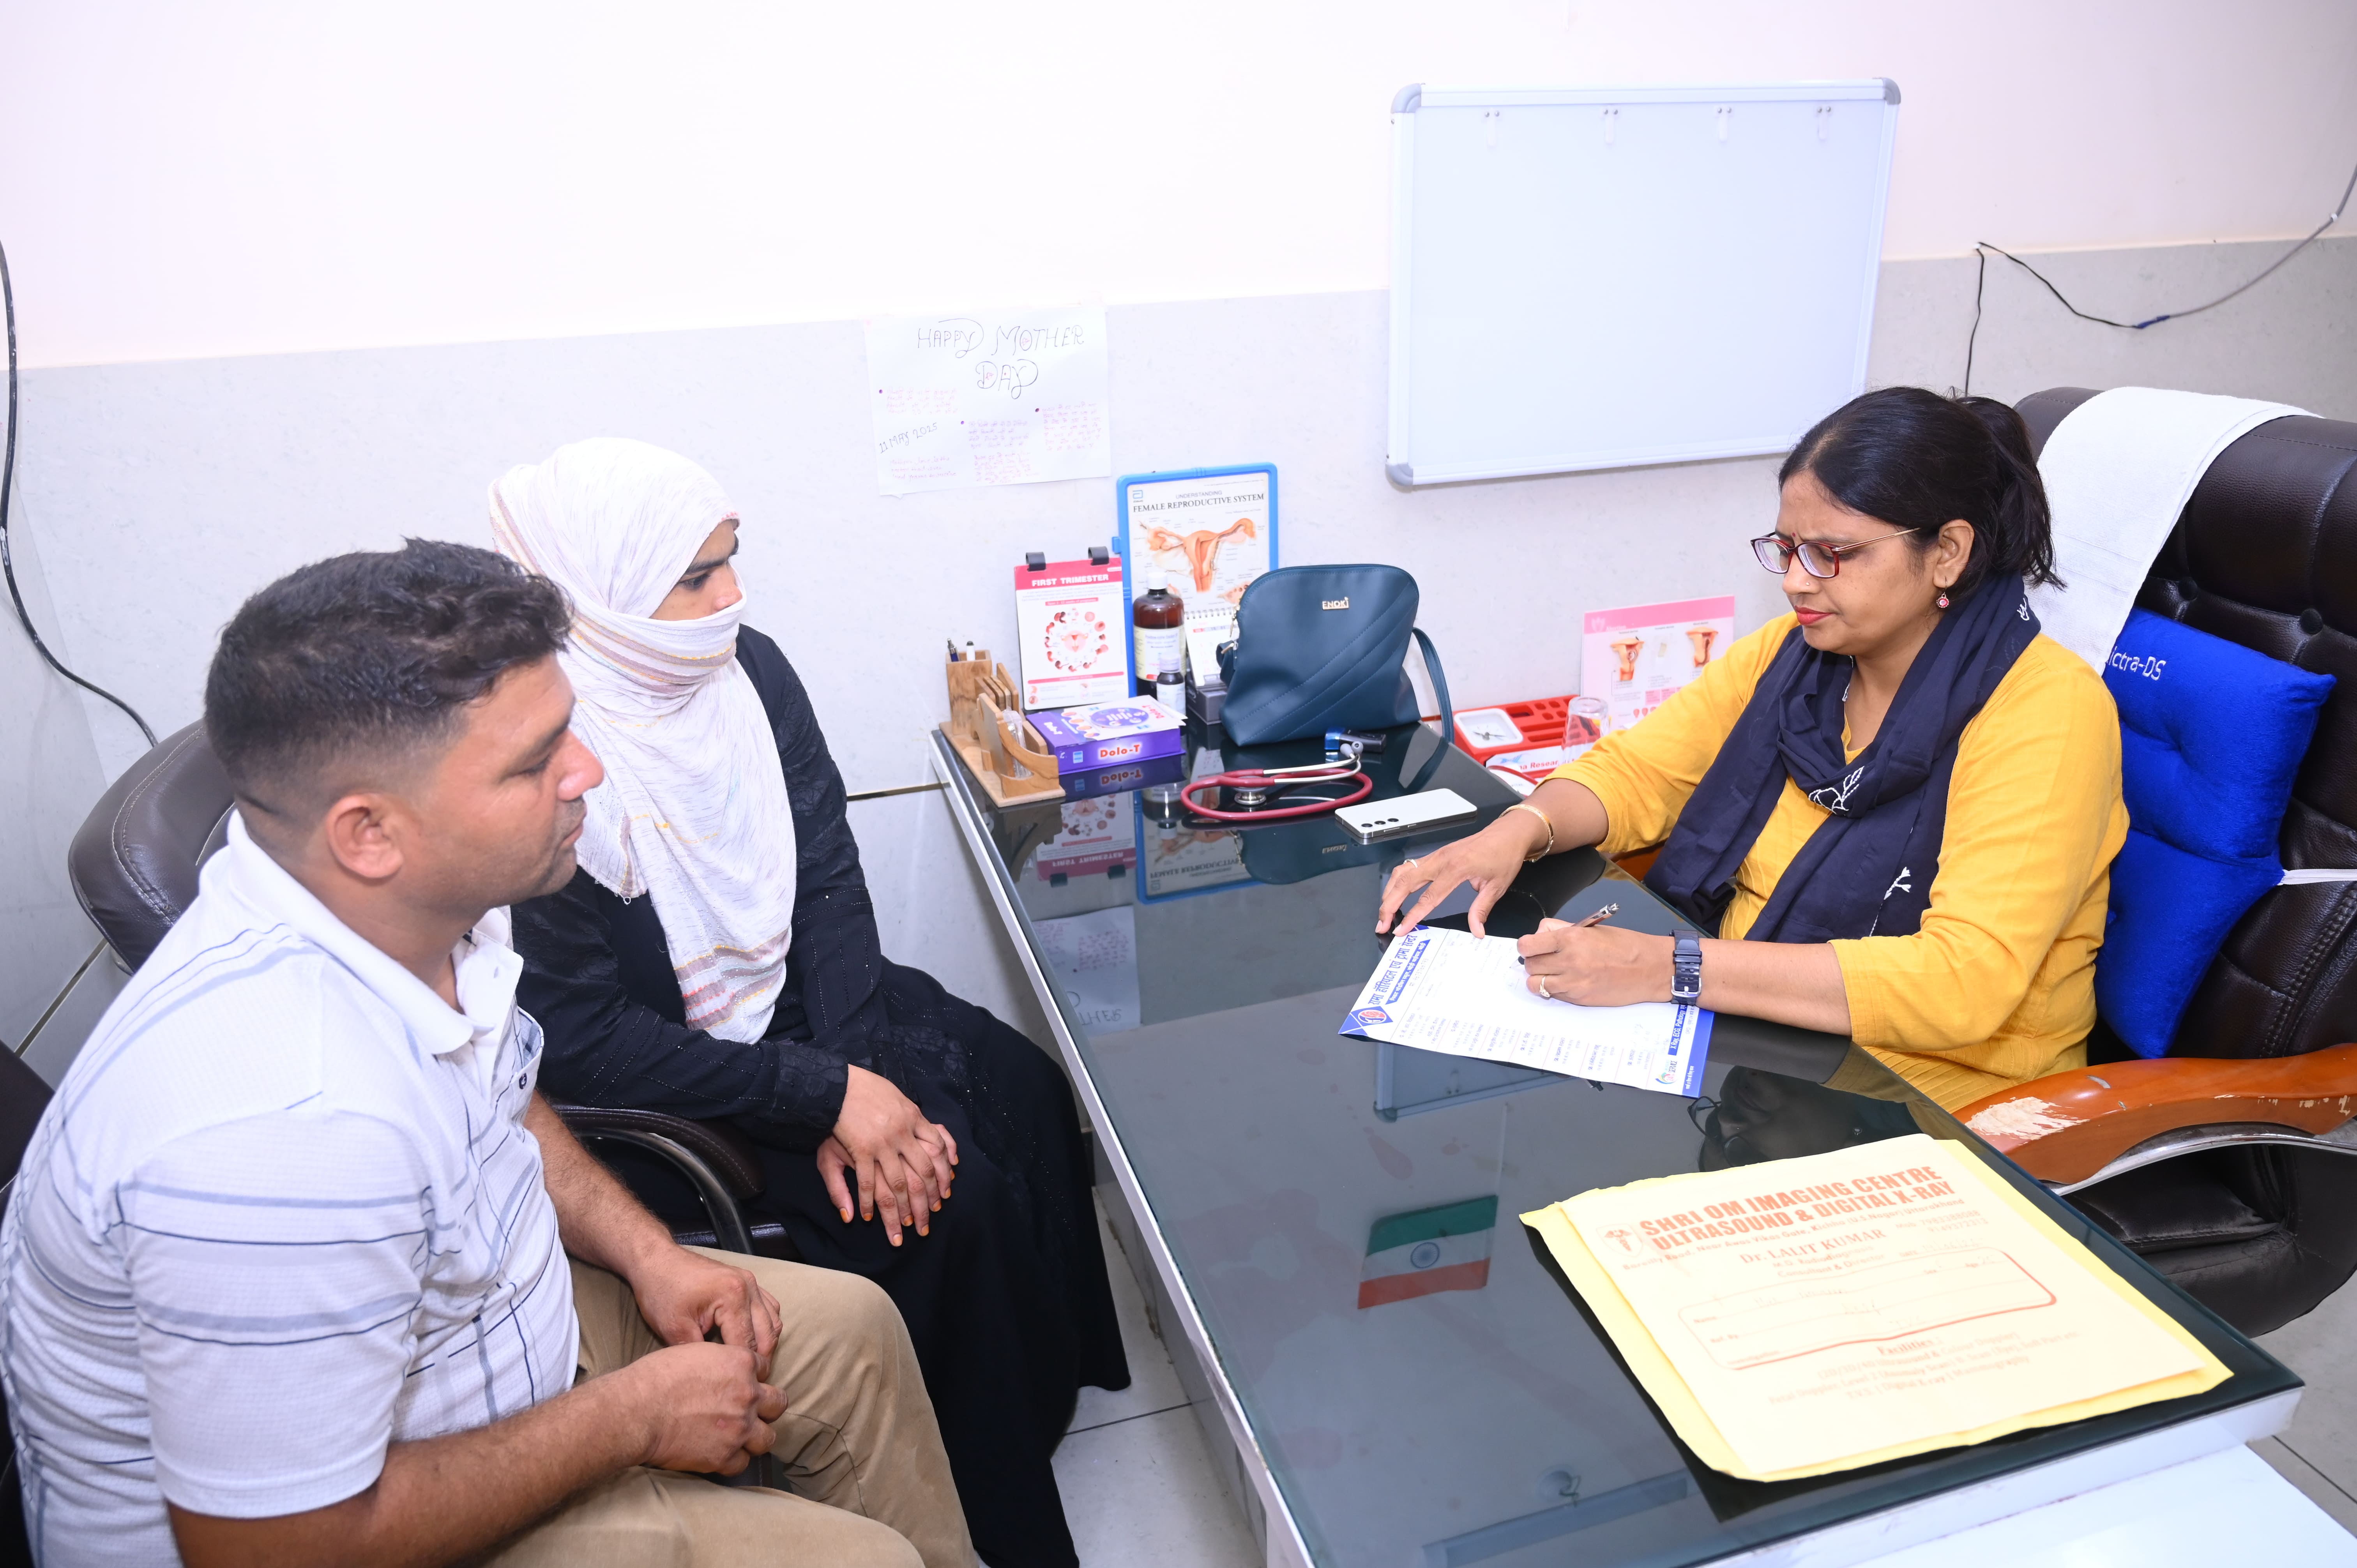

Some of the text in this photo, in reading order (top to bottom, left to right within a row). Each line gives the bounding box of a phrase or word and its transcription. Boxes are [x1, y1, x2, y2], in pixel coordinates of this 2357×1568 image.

[918, 318, 1084, 358] HAPPY MOTHER
[975, 359, 1038, 399] DAY
[889, 431, 909, 448] MAY
[913, 422, 937, 439] 2025
[1176, 490, 1222, 499] UNDERSTANDING
[1133, 493, 1264, 512] FEMALE REPRODUCTIVE SYSTEM
[1032, 574, 1109, 587] FIRST TRIMESTER
[2106, 646, 2166, 680] ictra-DS
[1100, 744, 1140, 758] Dolo-T
[1530, 760, 1559, 769] Resear
[1394, 948, 1410, 960] ट्रामा
[1389, 959, 1403, 969] एवं
[1368, 993, 1384, 1005] रामा
[1675, 1010, 1686, 1026] Pathology
[1673, 1027, 1682, 1037] ECG,
[1670, 1037, 1679, 1045] Ray,
[1668, 1060, 1678, 1073] SERVICE
[1640, 1166, 1941, 1235] SHRI OM IMAGING CENTRE
[1653, 1181, 1954, 1250] ULTRASOUND & DIGITAL X-RAY
[1622, 1258, 1663, 1270] Bareilly
[1664, 1250, 1691, 1261] Road,
[1696, 1243, 1721, 1252] Near
[1781, 1229, 1810, 1238] Gate,
[1810, 1221, 1846, 1231] Kichha
[1903, 1198, 1965, 1215] Uttarakhand
[1739, 1229, 1886, 1263] Dr. LALIT KUMAR
[1797, 1246, 1873, 1264] Radiodiagnosis
[1777, 1266, 1832, 1278] Consultant
[1843, 1254, 1884, 1268] Director
[1693, 1315, 1717, 1324] Name
[1876, 1340, 1933, 1355] Facilities
[1878, 1352, 1931, 1366] Ultrasound
